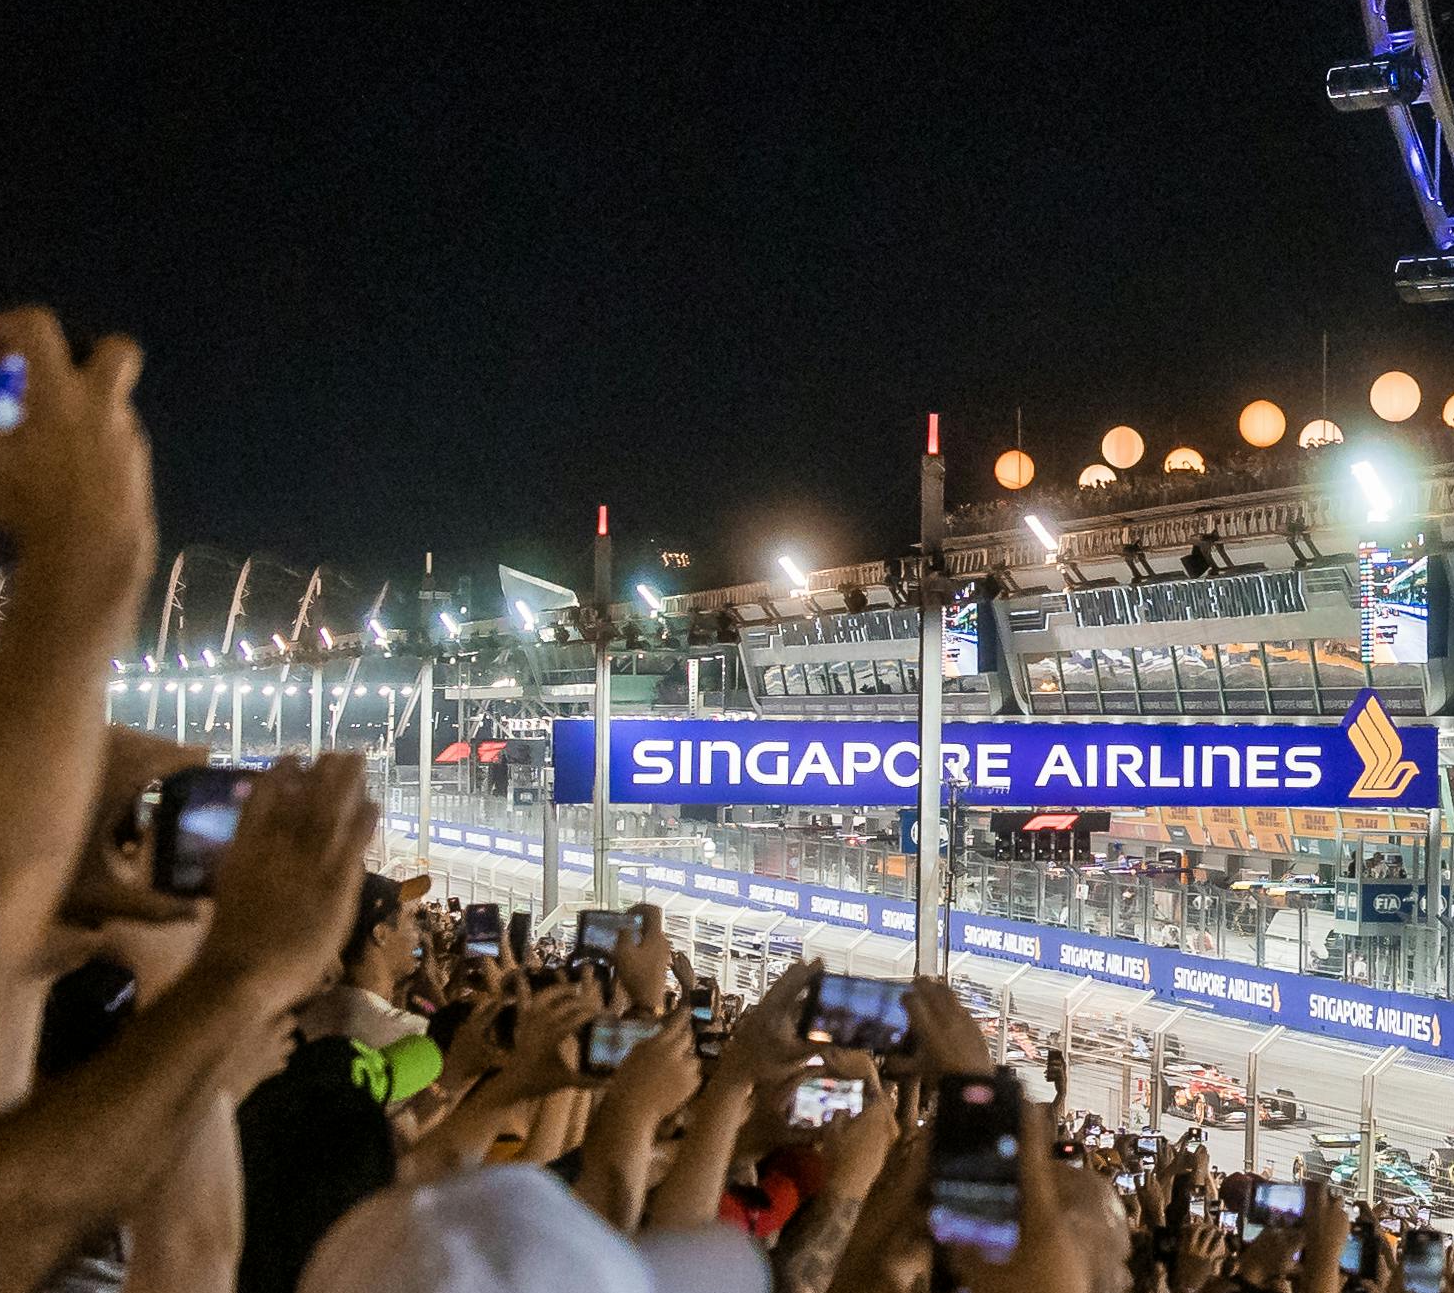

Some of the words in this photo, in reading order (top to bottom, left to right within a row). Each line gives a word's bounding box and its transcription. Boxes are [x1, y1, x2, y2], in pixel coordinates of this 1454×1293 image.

[1035, 742, 1323, 789] AIRLINES
[1375, 898, 1400, 910] FIA
[964, 924, 1001, 949] SINGAPORE
[1001, 931, 1035, 957] AIRLINES
[1060, 944, 1104, 972] SINGAPORE
[1106, 954, 1144, 982] AIRLINES
[1173, 966, 1226, 997] SINGAPORE
[1228, 977, 1272, 1009] AIRLINES
[1309, 994, 1374, 1029] SINGAPORE
[1376, 1007, 1431, 1042] AIRLINES
